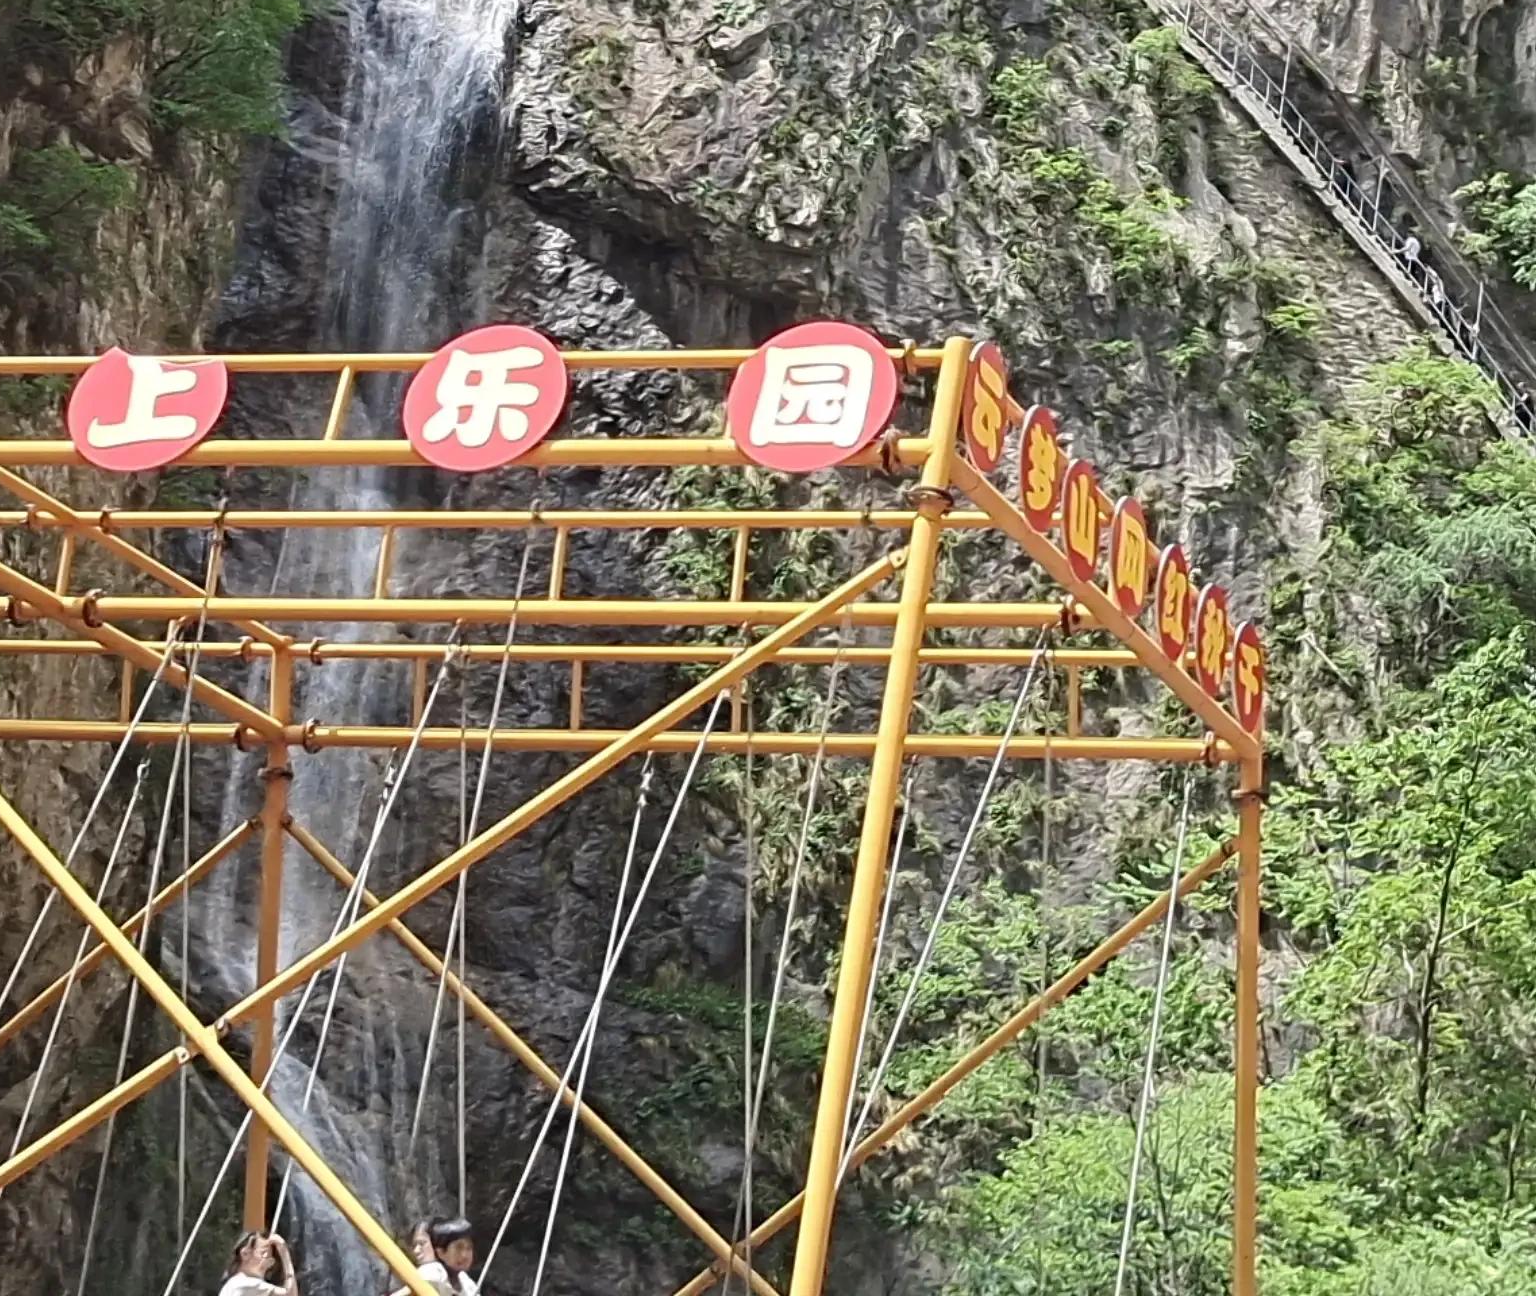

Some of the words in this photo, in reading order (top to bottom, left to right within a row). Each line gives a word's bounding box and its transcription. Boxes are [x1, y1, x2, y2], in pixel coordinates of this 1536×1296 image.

[971, 359, 1261, 715] 云梦山网红秋千
